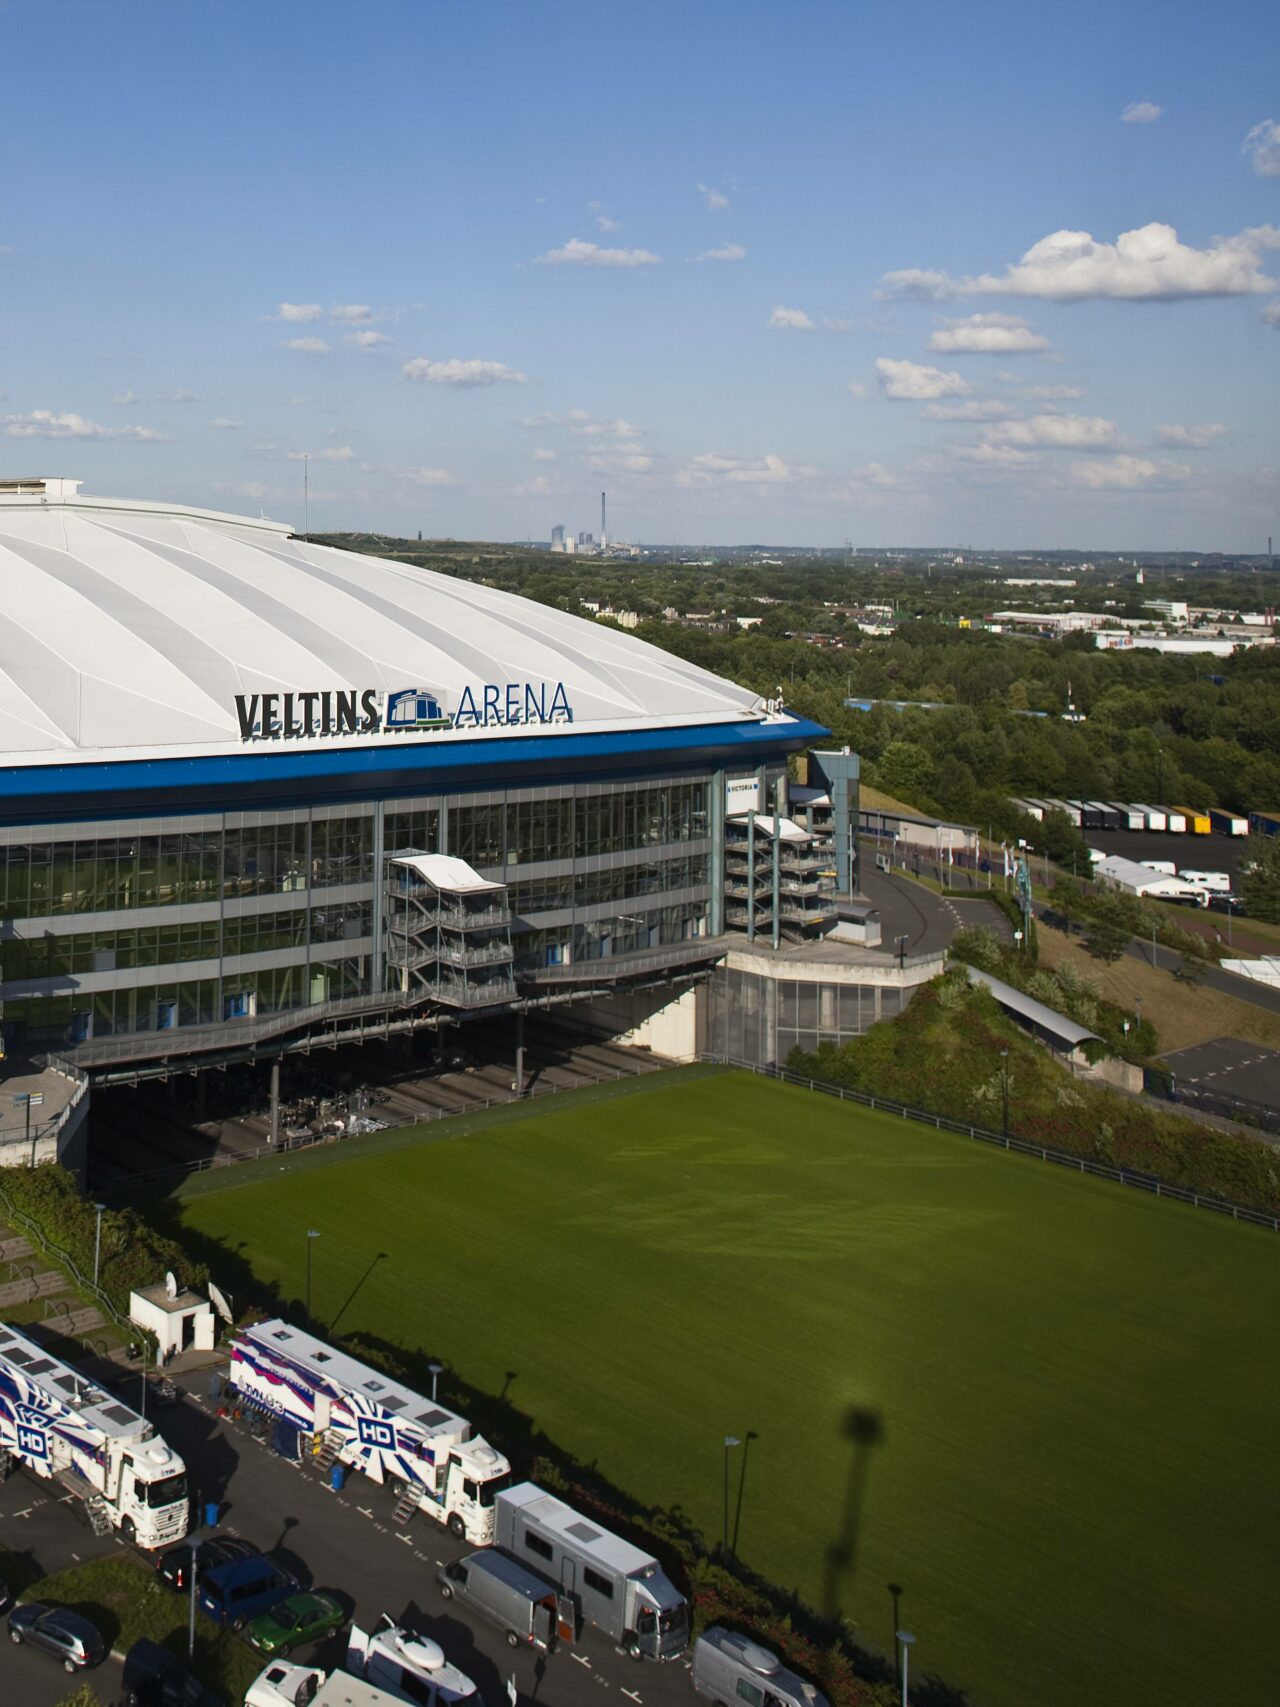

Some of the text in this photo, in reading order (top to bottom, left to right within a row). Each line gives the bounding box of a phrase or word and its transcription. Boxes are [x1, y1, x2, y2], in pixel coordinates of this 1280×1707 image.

[234, 682, 573, 739] VELTINS ARENA
[731, 784, 752, 793] VICTORIA
[245, 1382, 264, 1402] TVN
[19, 1429, 44, 1452] HD
[361, 1422, 391, 1444] HD
